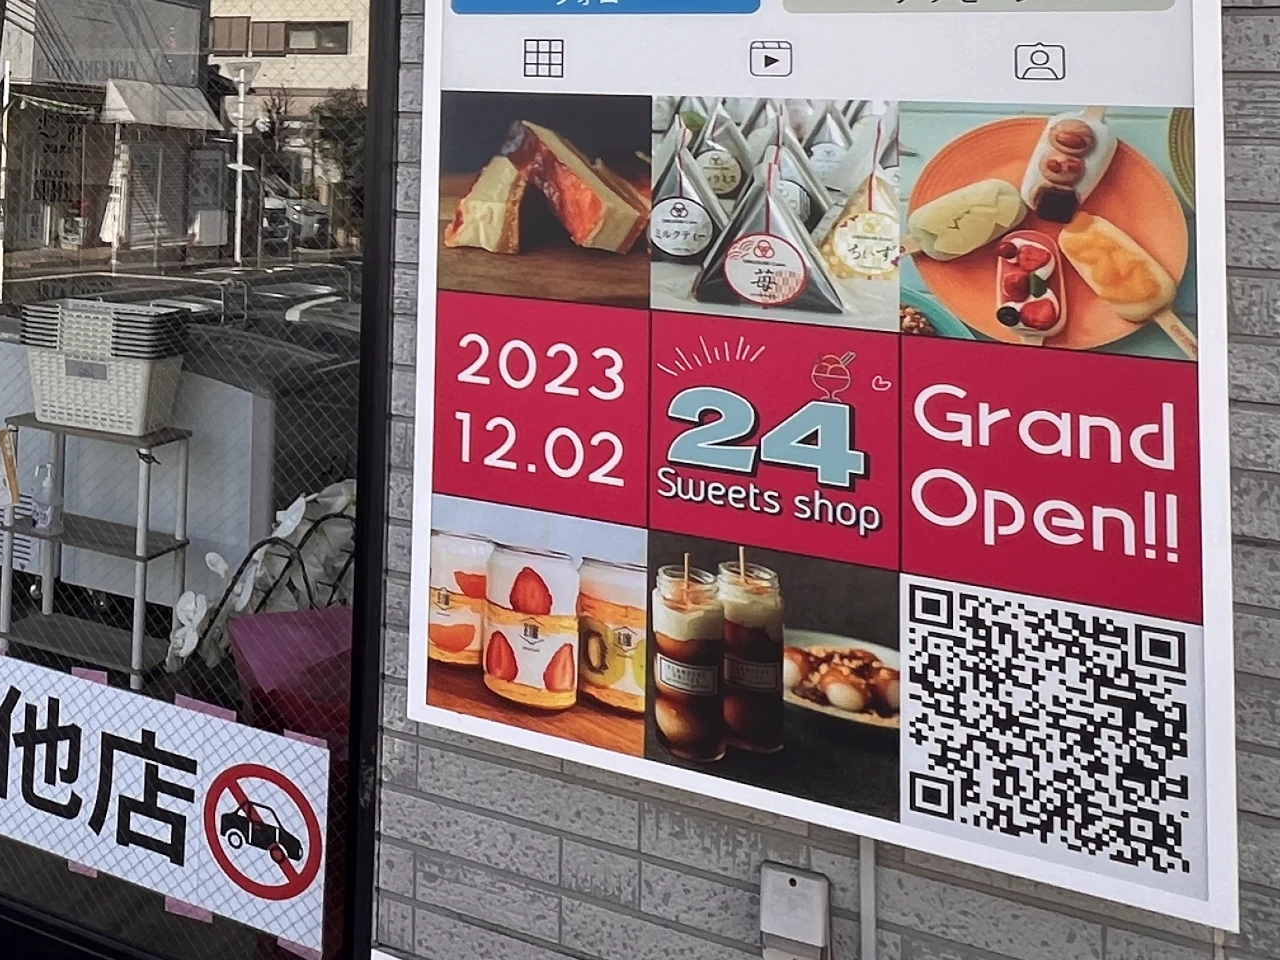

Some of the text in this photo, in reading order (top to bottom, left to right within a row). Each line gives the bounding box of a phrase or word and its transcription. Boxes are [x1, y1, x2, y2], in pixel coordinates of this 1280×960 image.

[457, 332, 626, 401] 2023
[454, 411, 625, 488] 12.02
[666, 386, 868, 490] 24
[913, 382, 1176, 472] Grand
[656, 465, 882, 538] Sweets shop
[910, 467, 1181, 563] Open!!
